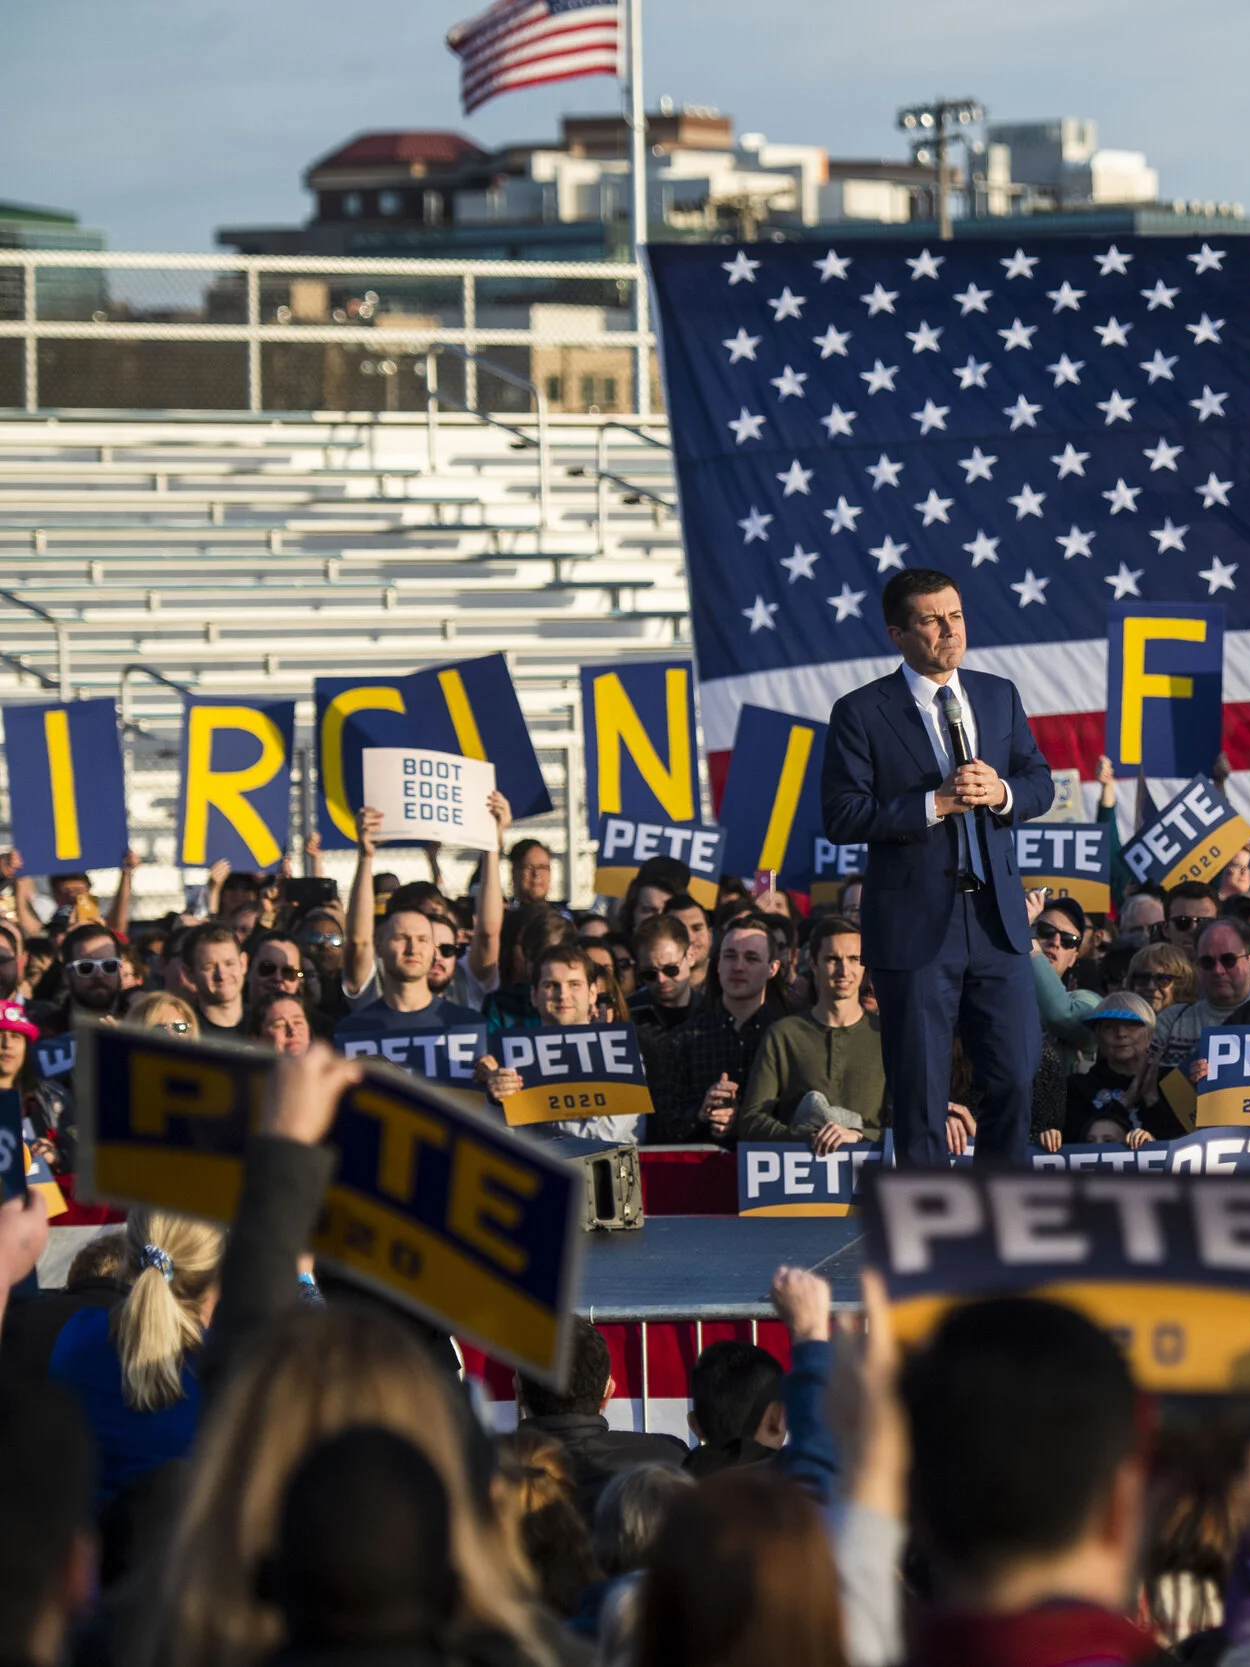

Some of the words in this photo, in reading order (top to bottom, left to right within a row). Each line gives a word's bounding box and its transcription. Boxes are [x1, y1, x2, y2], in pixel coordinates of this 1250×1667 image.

[403, 757, 463, 781] BOOT
[404, 780, 463, 804] EDGE
[404, 802, 464, 826] EDGE
[603, 818, 721, 874] PETE
[1015, 829, 1103, 872] ETE
[1124, 782, 1225, 884] PETE
[814, 837, 868, 875] PE
[1178, 845, 1222, 882] 2020
[502, 1030, 634, 1076] PETE
[548, 1092, 606, 1109] 2020
